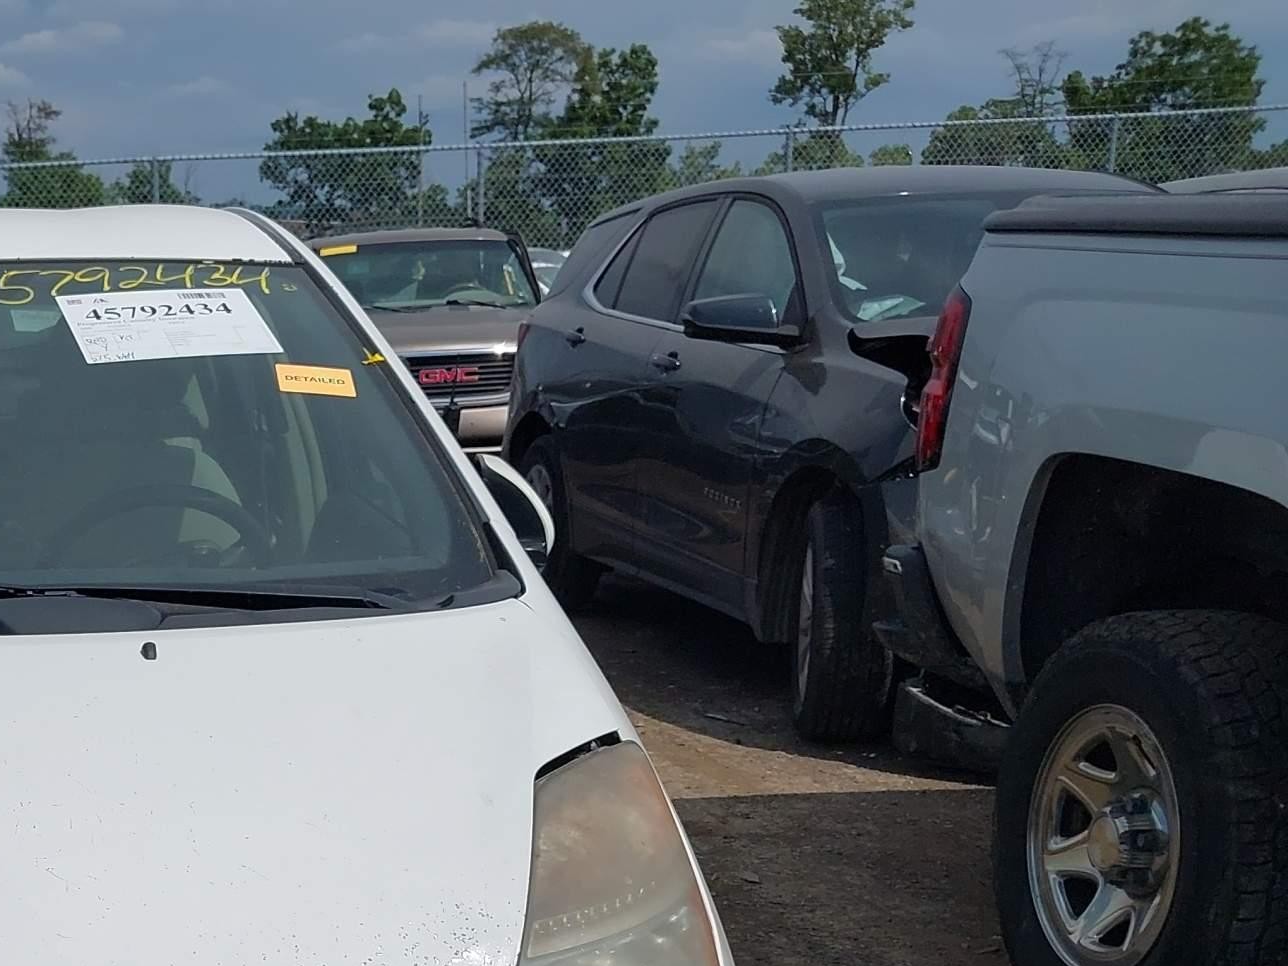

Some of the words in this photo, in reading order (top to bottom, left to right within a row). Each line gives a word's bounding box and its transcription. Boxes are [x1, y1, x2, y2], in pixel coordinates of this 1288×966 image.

[85, 302, 233, 321] 45792434
[284, 375, 346, 385] DETAILED
[418, 367, 479, 384] GMC
